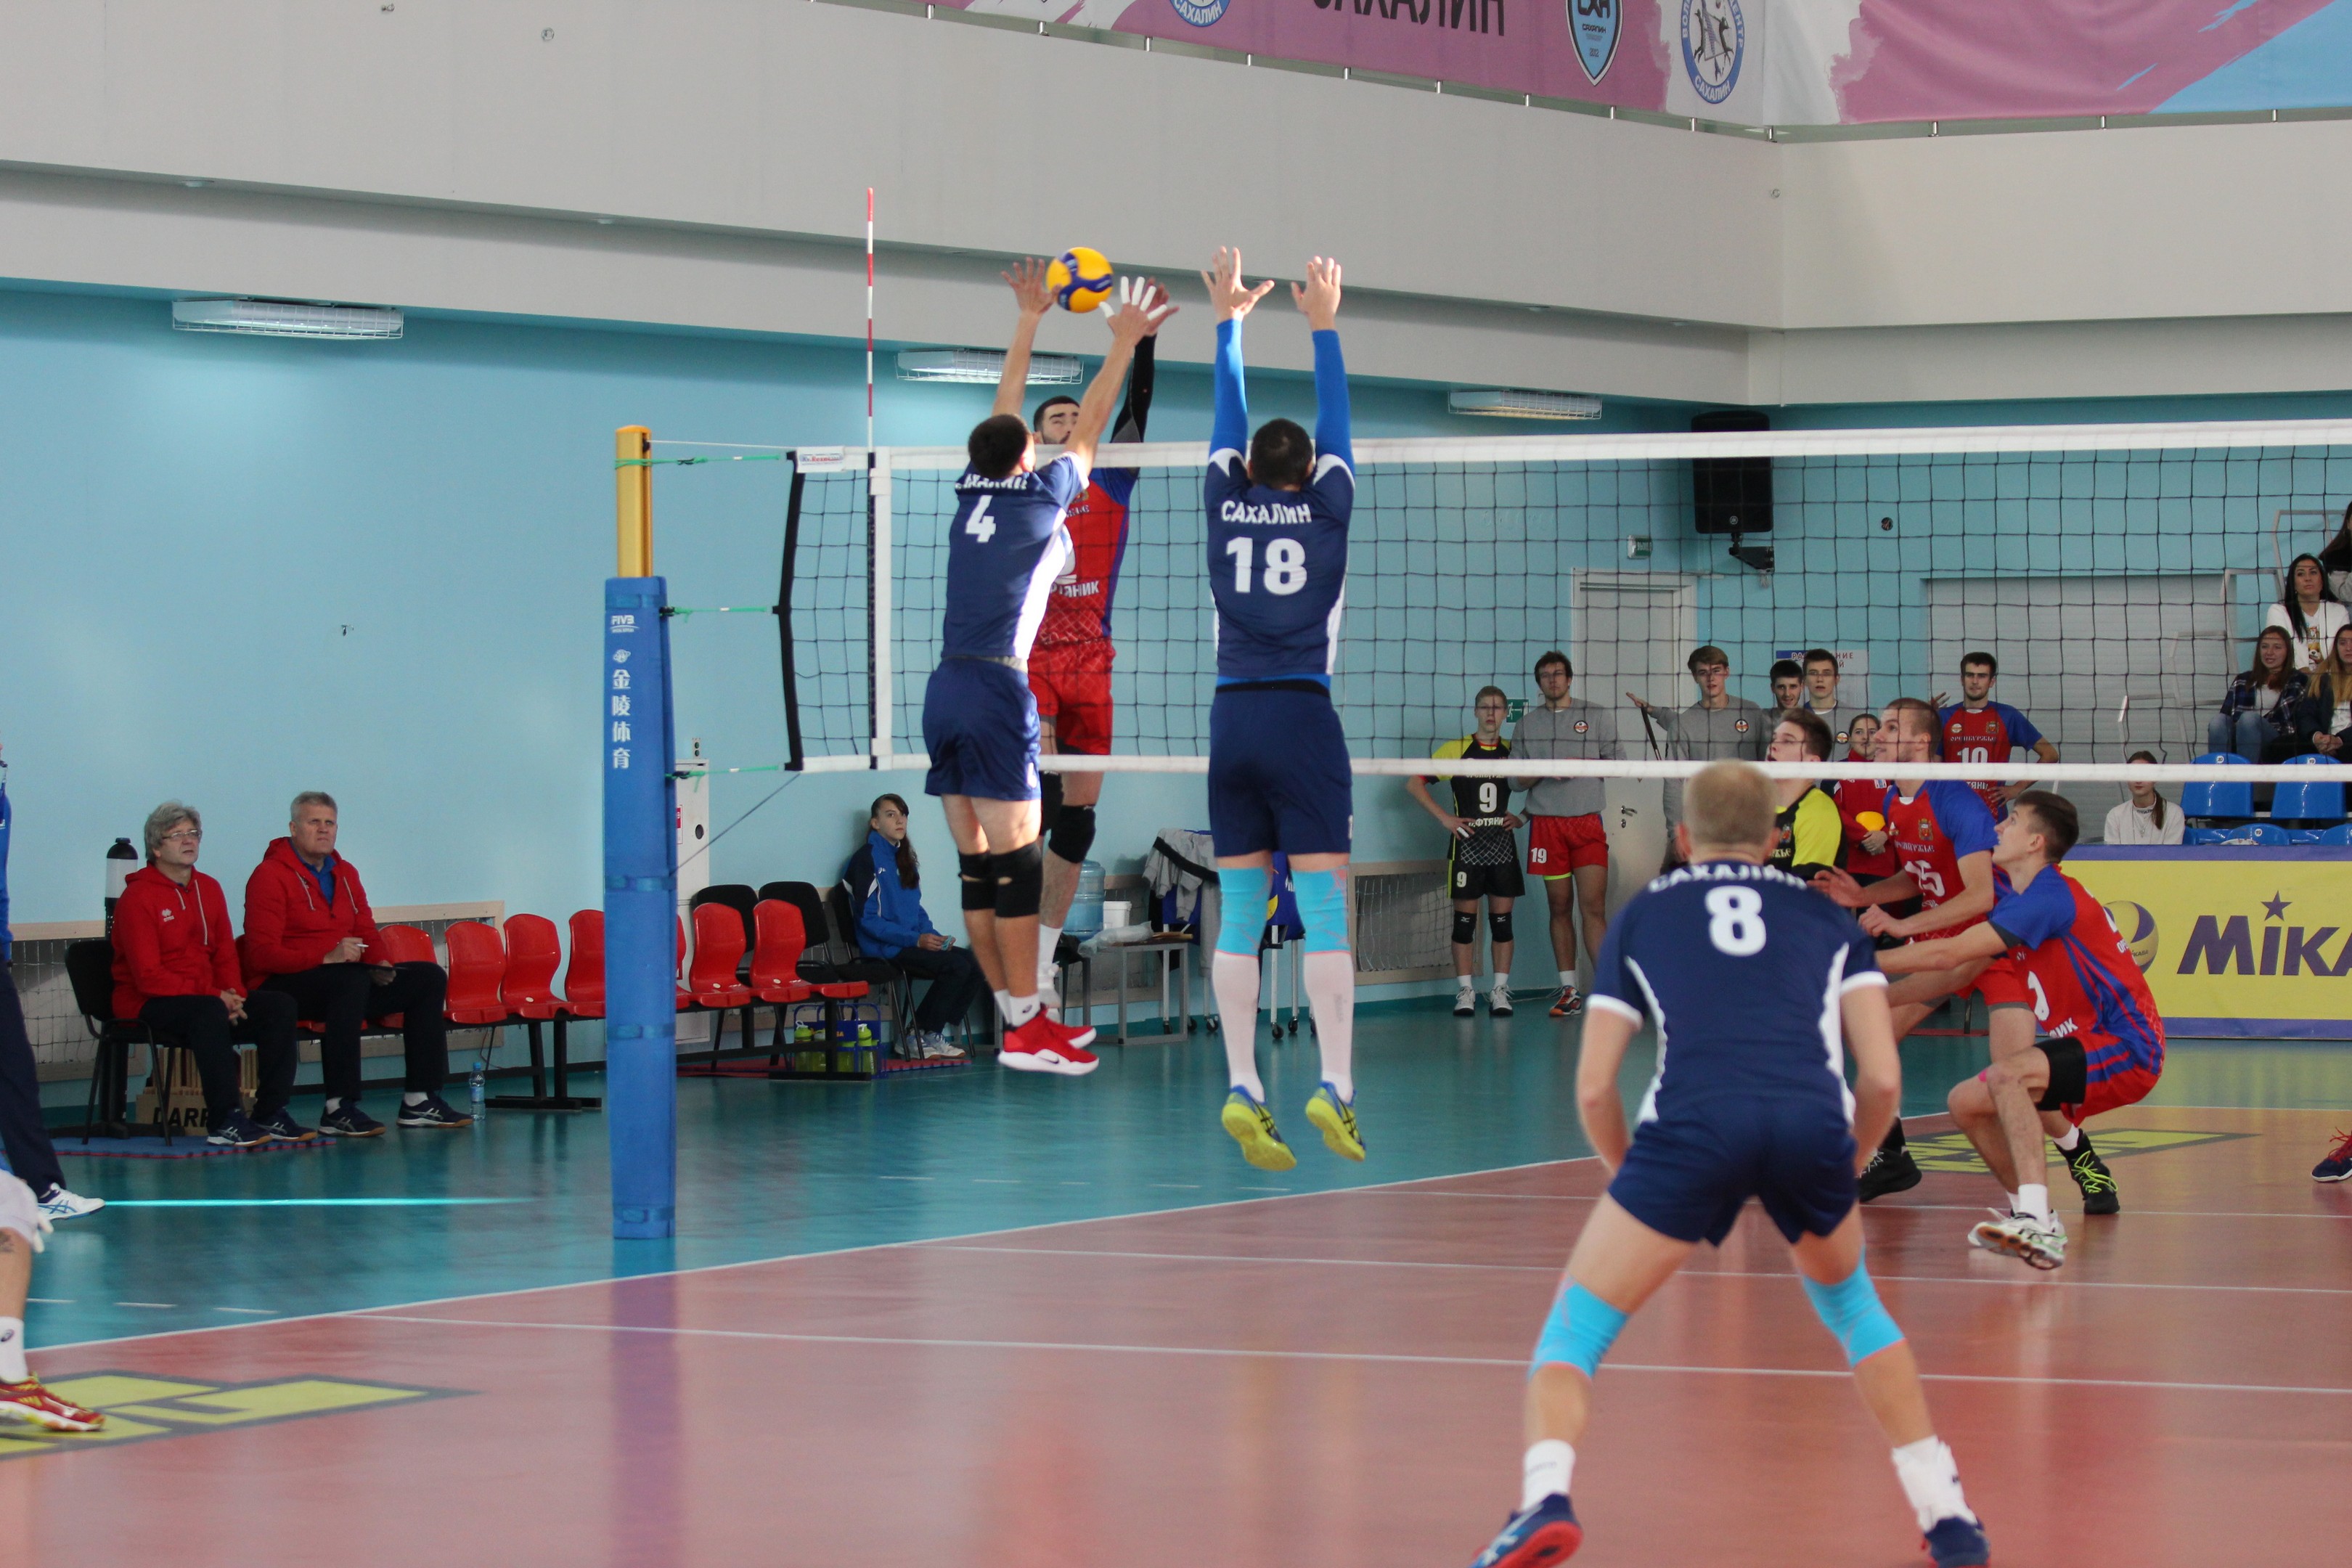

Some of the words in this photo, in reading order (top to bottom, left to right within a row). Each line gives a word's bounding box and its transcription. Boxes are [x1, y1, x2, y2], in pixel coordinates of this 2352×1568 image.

[1175, 0, 1222, 24] САХАЛИН
[1695, 75, 1731, 101] САХАЛИН
[965, 494, 997, 543] 4
[1221, 499, 1312, 525] САХАЛИН
[1226, 536, 1307, 596] 18
[611, 615, 635, 625] FIVB
[611, 669, 632, 769] 金陵体育
[1479, 782, 1498, 813] 9
[1531, 847, 1547, 863] 19
[1456, 871, 1467, 887] 9
[1904, 859, 1945, 897] 15
[1704, 885, 1767, 957] 8
